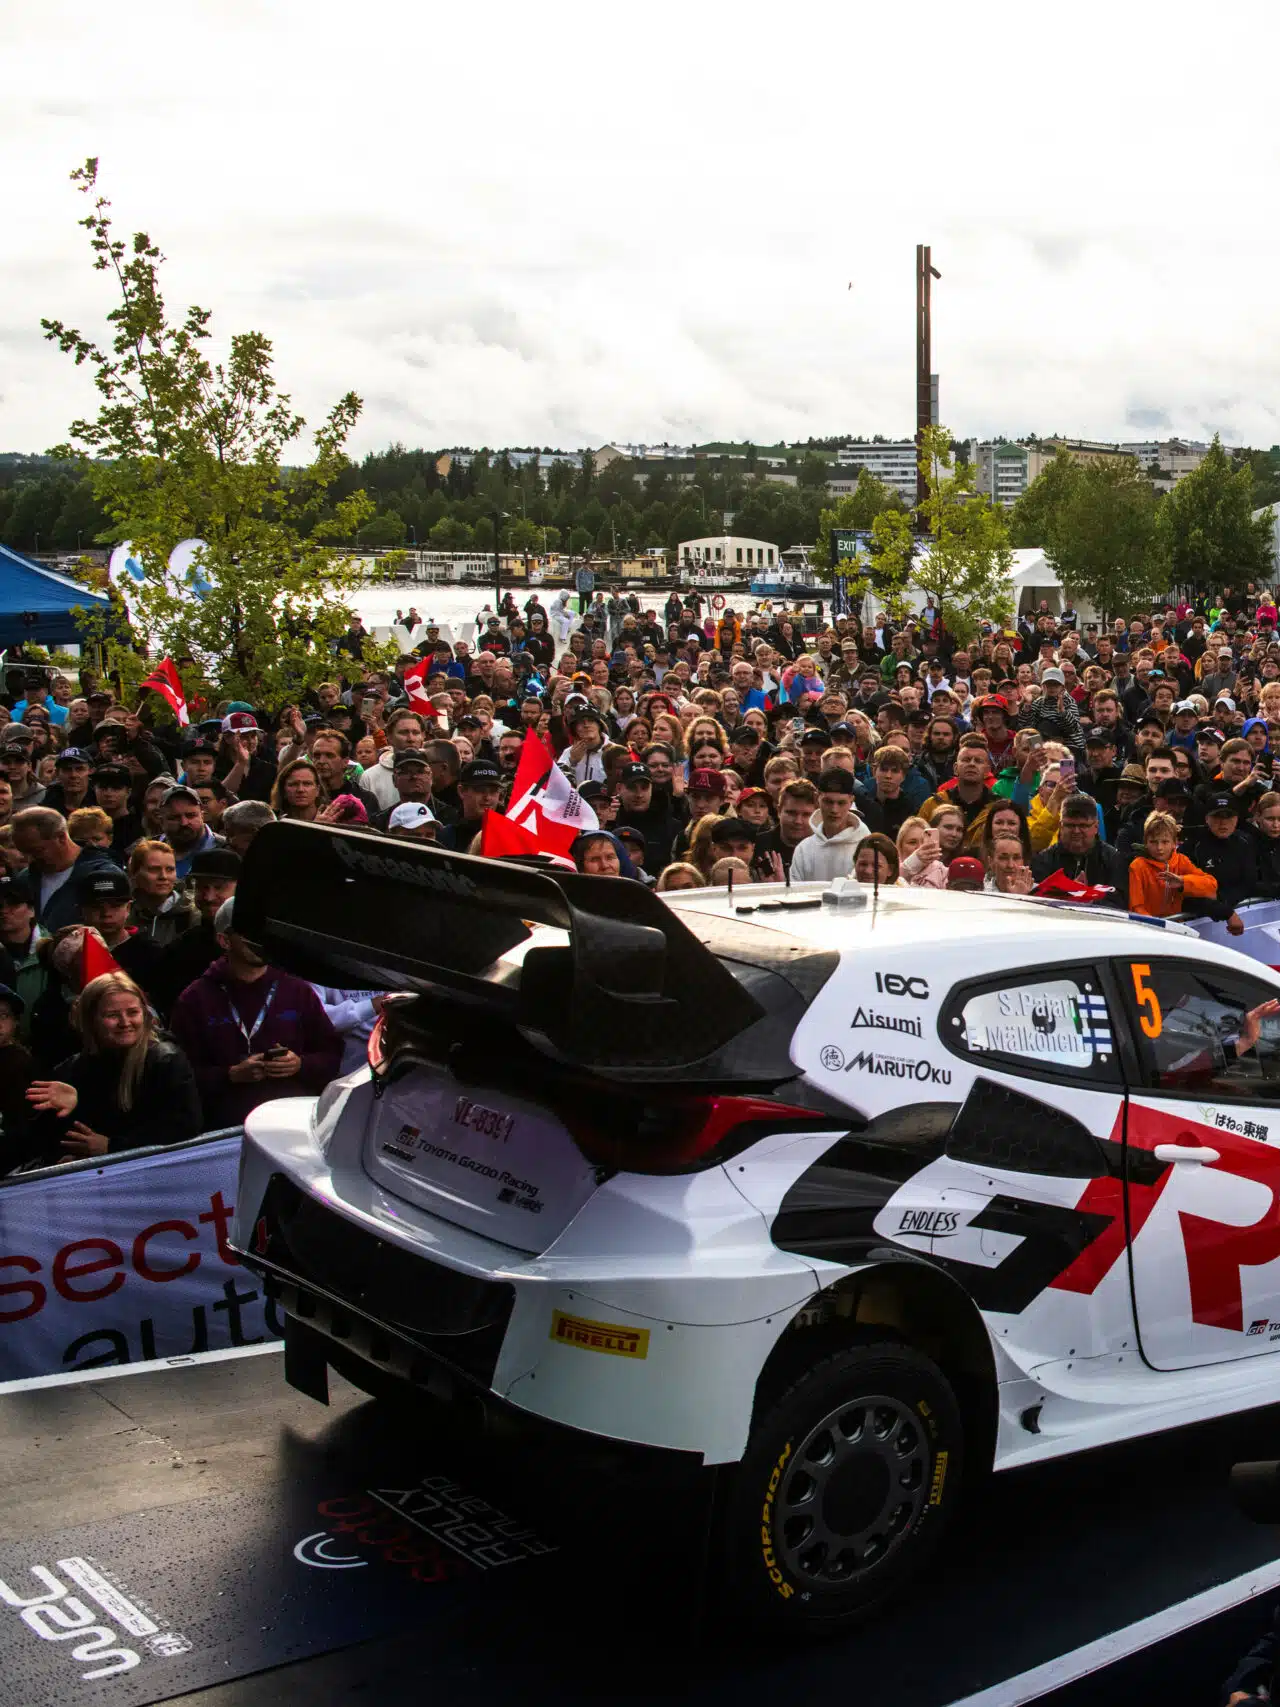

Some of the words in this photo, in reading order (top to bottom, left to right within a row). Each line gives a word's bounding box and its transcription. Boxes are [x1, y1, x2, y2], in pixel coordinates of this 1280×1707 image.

[837, 540, 855, 550] EXIT
[1130, 963, 1163, 1039] 5
[851, 1007, 922, 1038] Aisumi
[1214, 1112, 1268, 1141] ばねの東郷
[417, 1138, 457, 1163] TOYOTA
[458, 1156, 499, 1179] GAZOO
[499, 1171, 539, 1197] Racing
[899, 1210, 960, 1231] ENDLESS
[556, 1317, 640, 1352] PIRELLI
[761, 1442, 794, 1599] SCORPION
